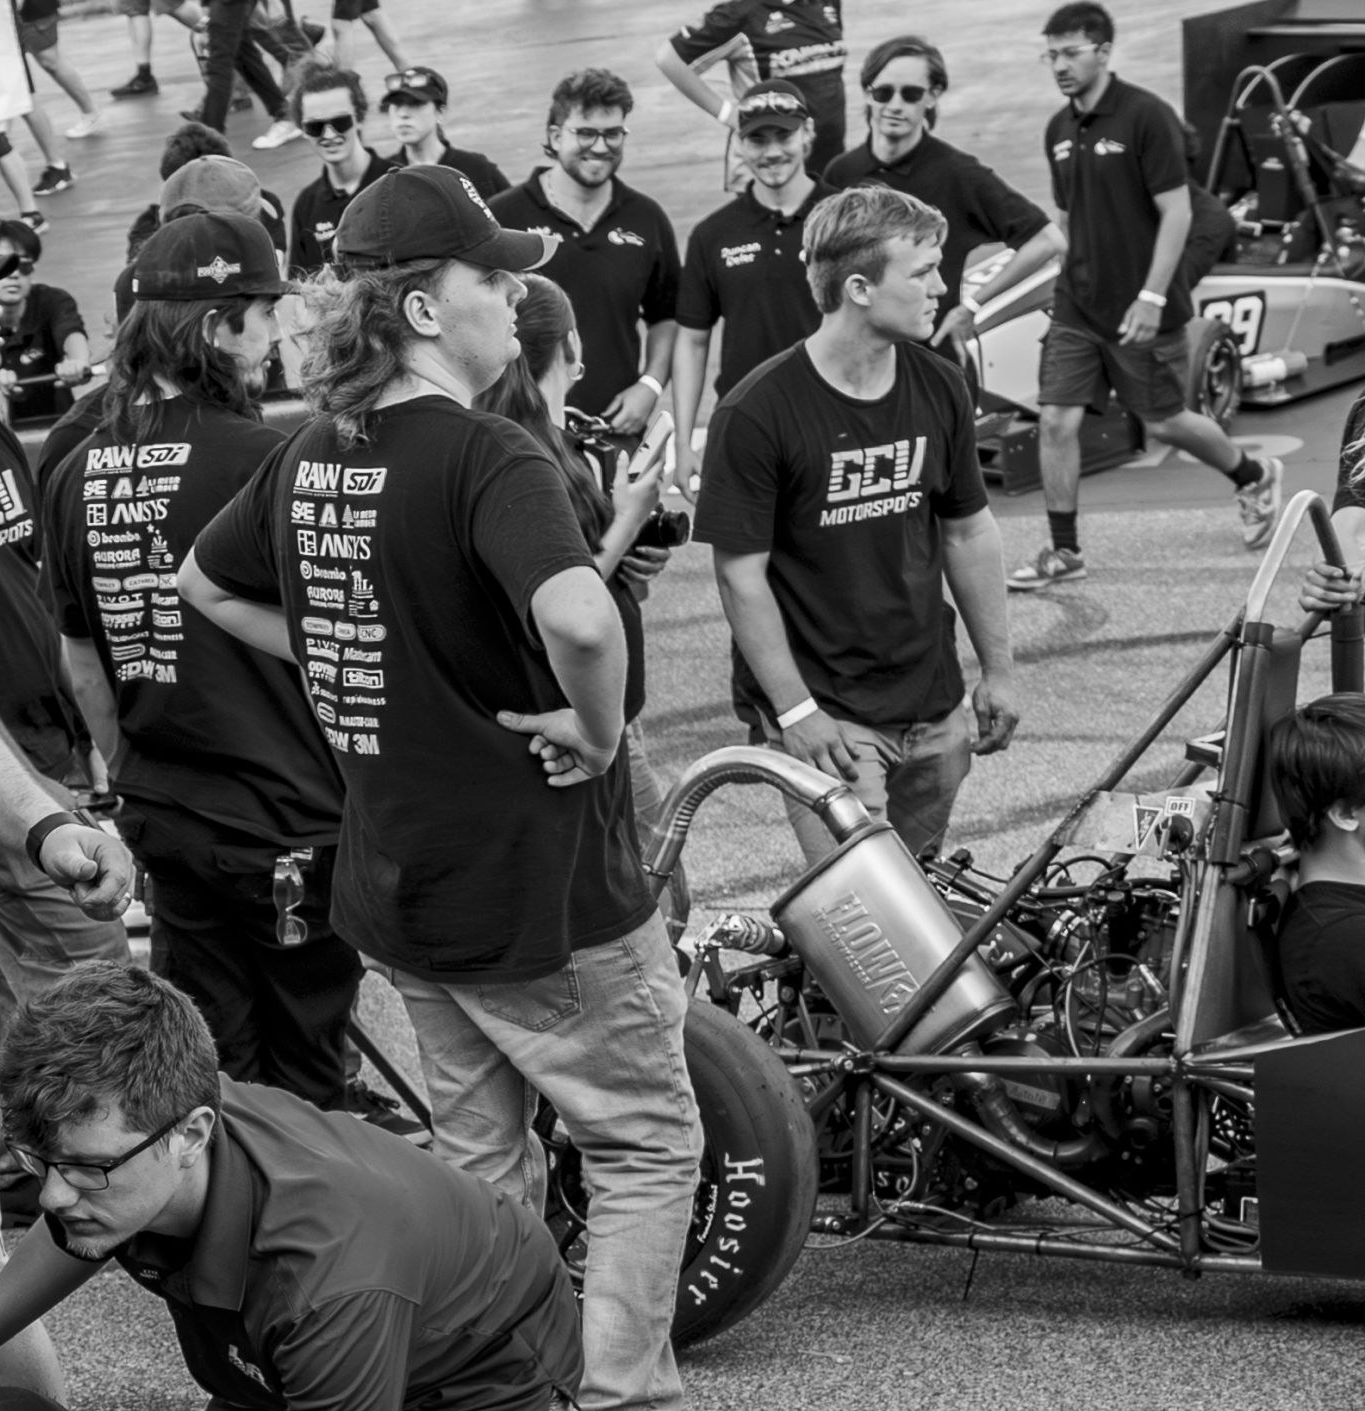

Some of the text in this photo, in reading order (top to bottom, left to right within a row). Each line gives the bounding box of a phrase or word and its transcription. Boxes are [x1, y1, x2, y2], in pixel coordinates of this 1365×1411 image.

[86, 443, 136, 471] RAW
[294, 460, 342, 491] RAW
[110, 498, 171, 525] ANSYS
[93, 548, 141, 563] AURORA
[320, 533, 371, 560] ANSYS
[352, 733, 380, 755] 3M
[687, 1151, 766, 1306] Hoosier
